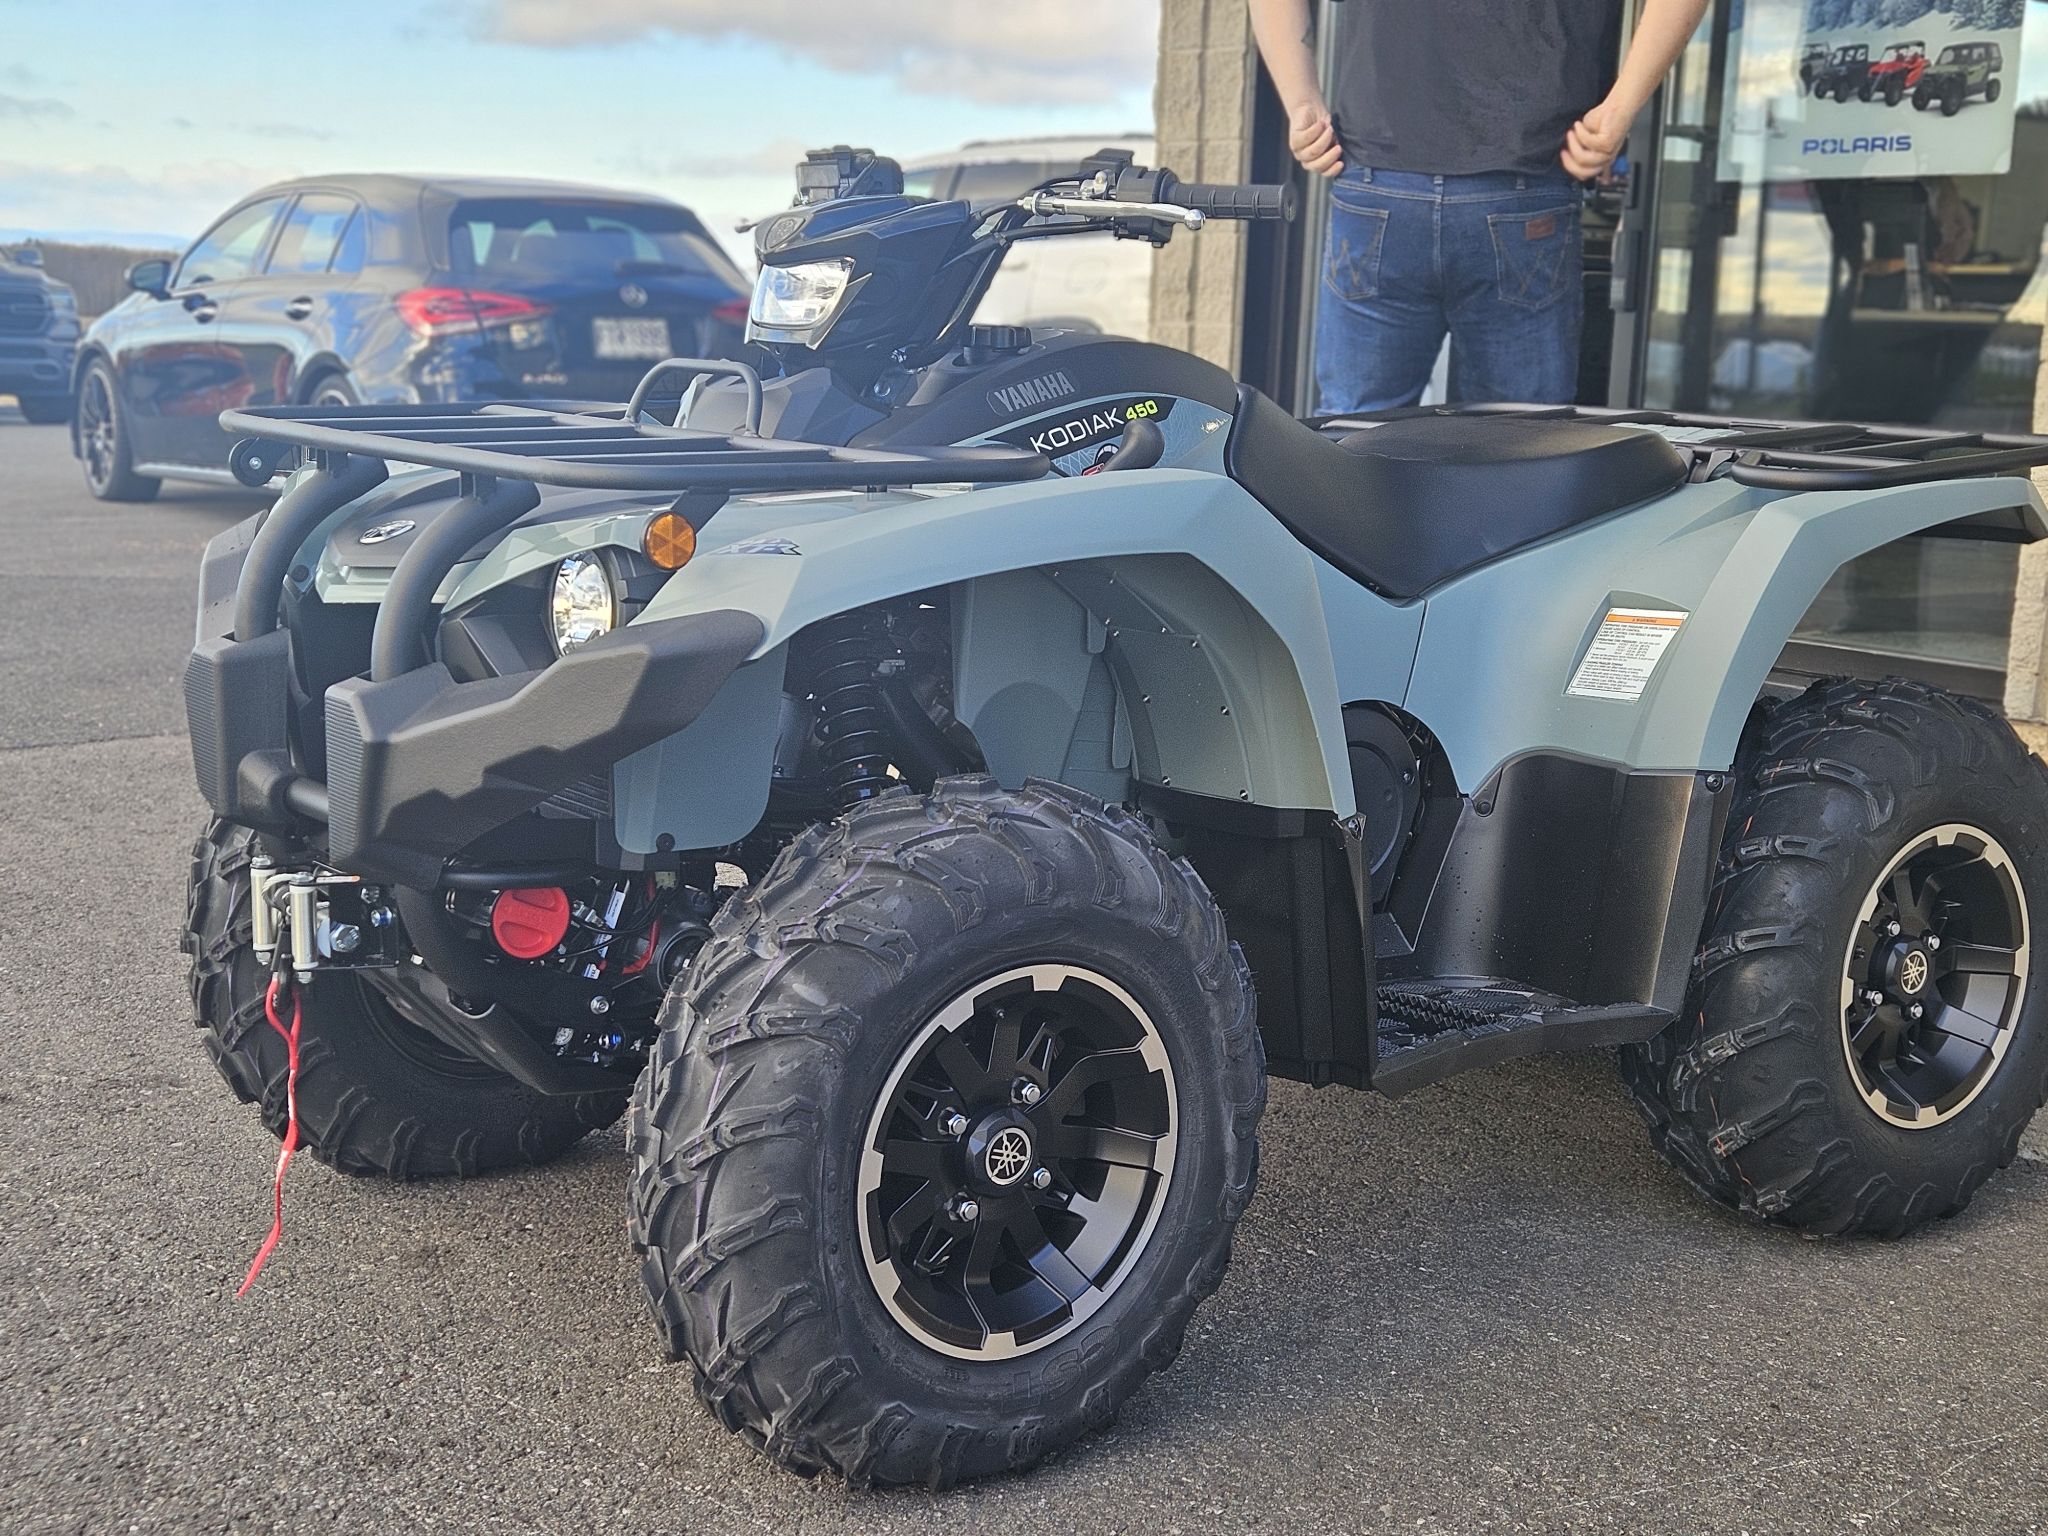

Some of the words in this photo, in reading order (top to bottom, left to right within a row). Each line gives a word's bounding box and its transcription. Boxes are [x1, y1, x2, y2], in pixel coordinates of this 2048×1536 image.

[1801, 135, 1913, 155] POLARIS
[994, 371, 1075, 412] YAMAHA
[1029, 407, 1125, 454] KODIAK
[1125, 399, 1158, 420] 450
